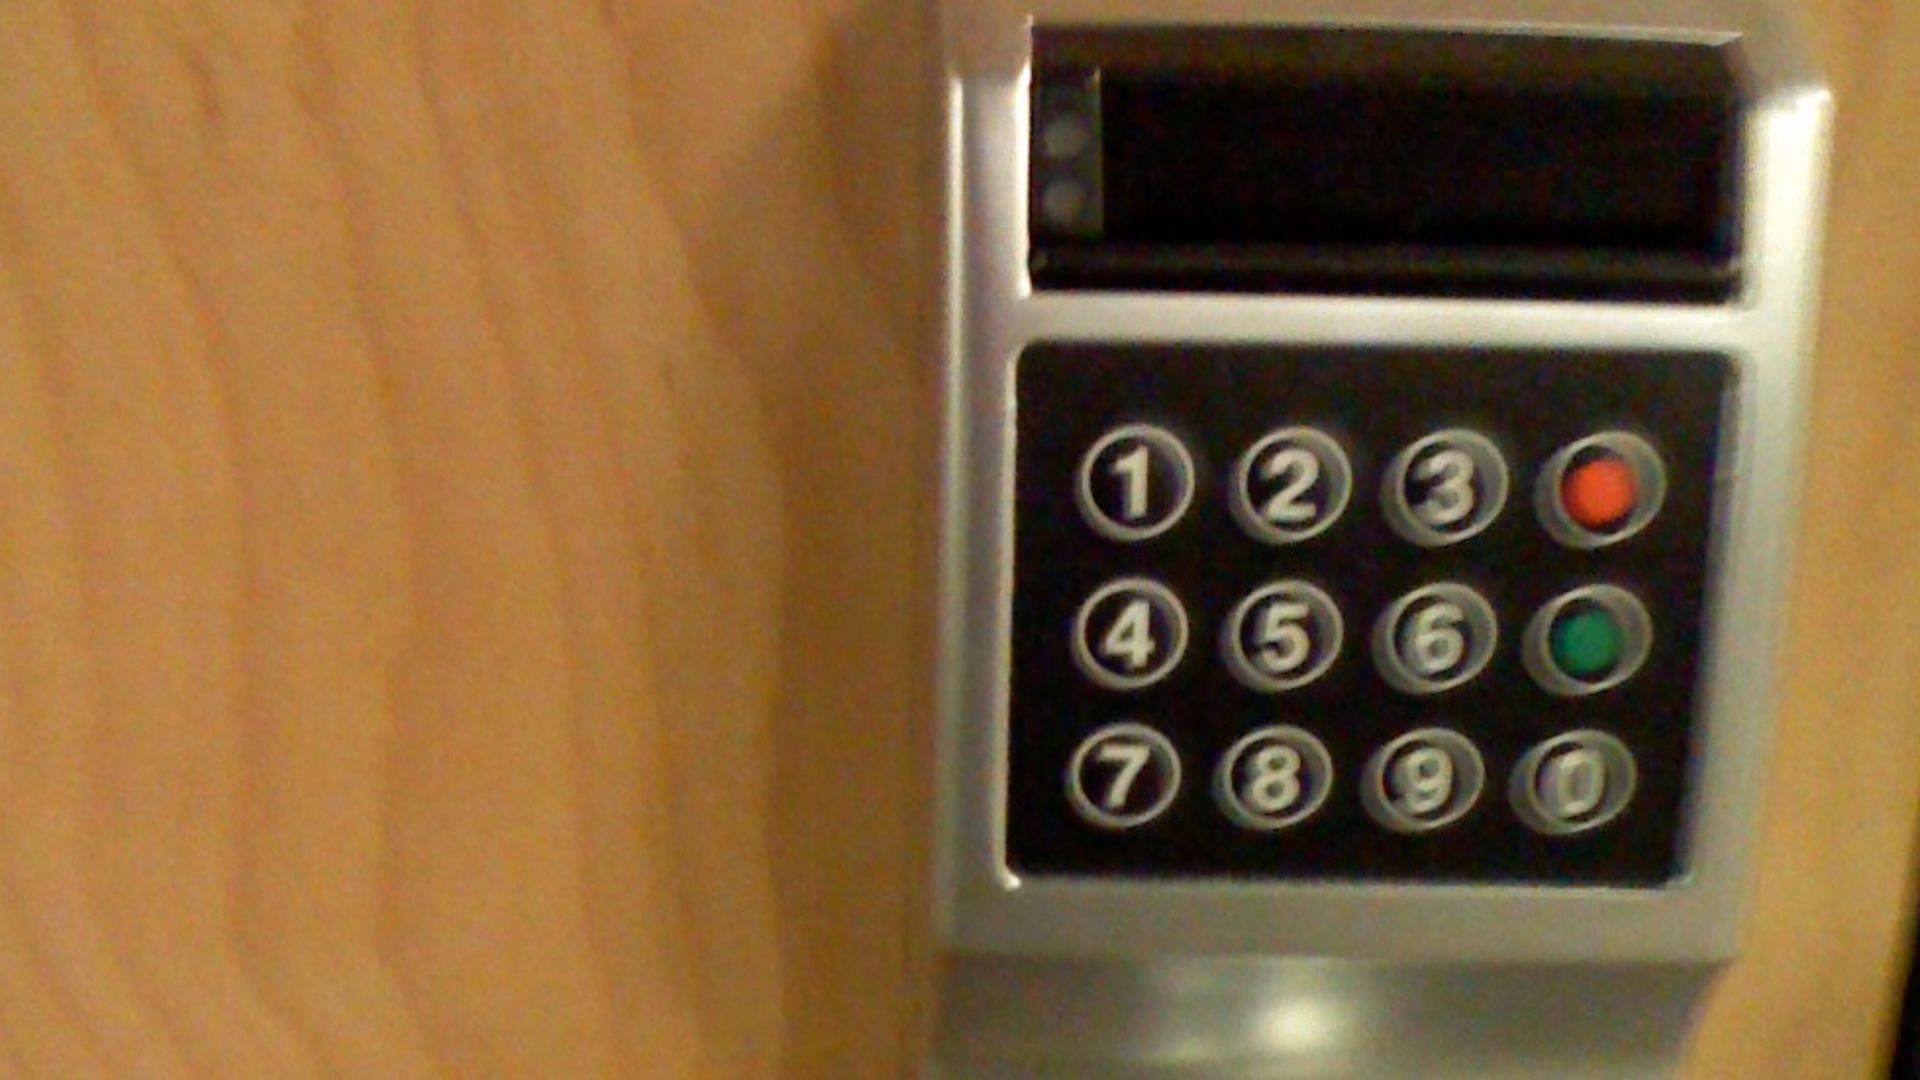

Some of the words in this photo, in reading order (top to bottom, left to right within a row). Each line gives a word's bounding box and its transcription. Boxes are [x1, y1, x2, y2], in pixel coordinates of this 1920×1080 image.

[1111, 444, 1150, 519] 1
[1260, 447, 1320, 524] 2
[1417, 448, 1474, 526] 3
[1104, 600, 1154, 670] 4
[1254, 601, 1311, 674] 5
[1412, 602, 1466, 674] 6
[1097, 743, 1151, 808] 7
[1251, 745, 1300, 812] 8
[1404, 746, 1454, 814] 9
[1556, 750, 1606, 818] 0
